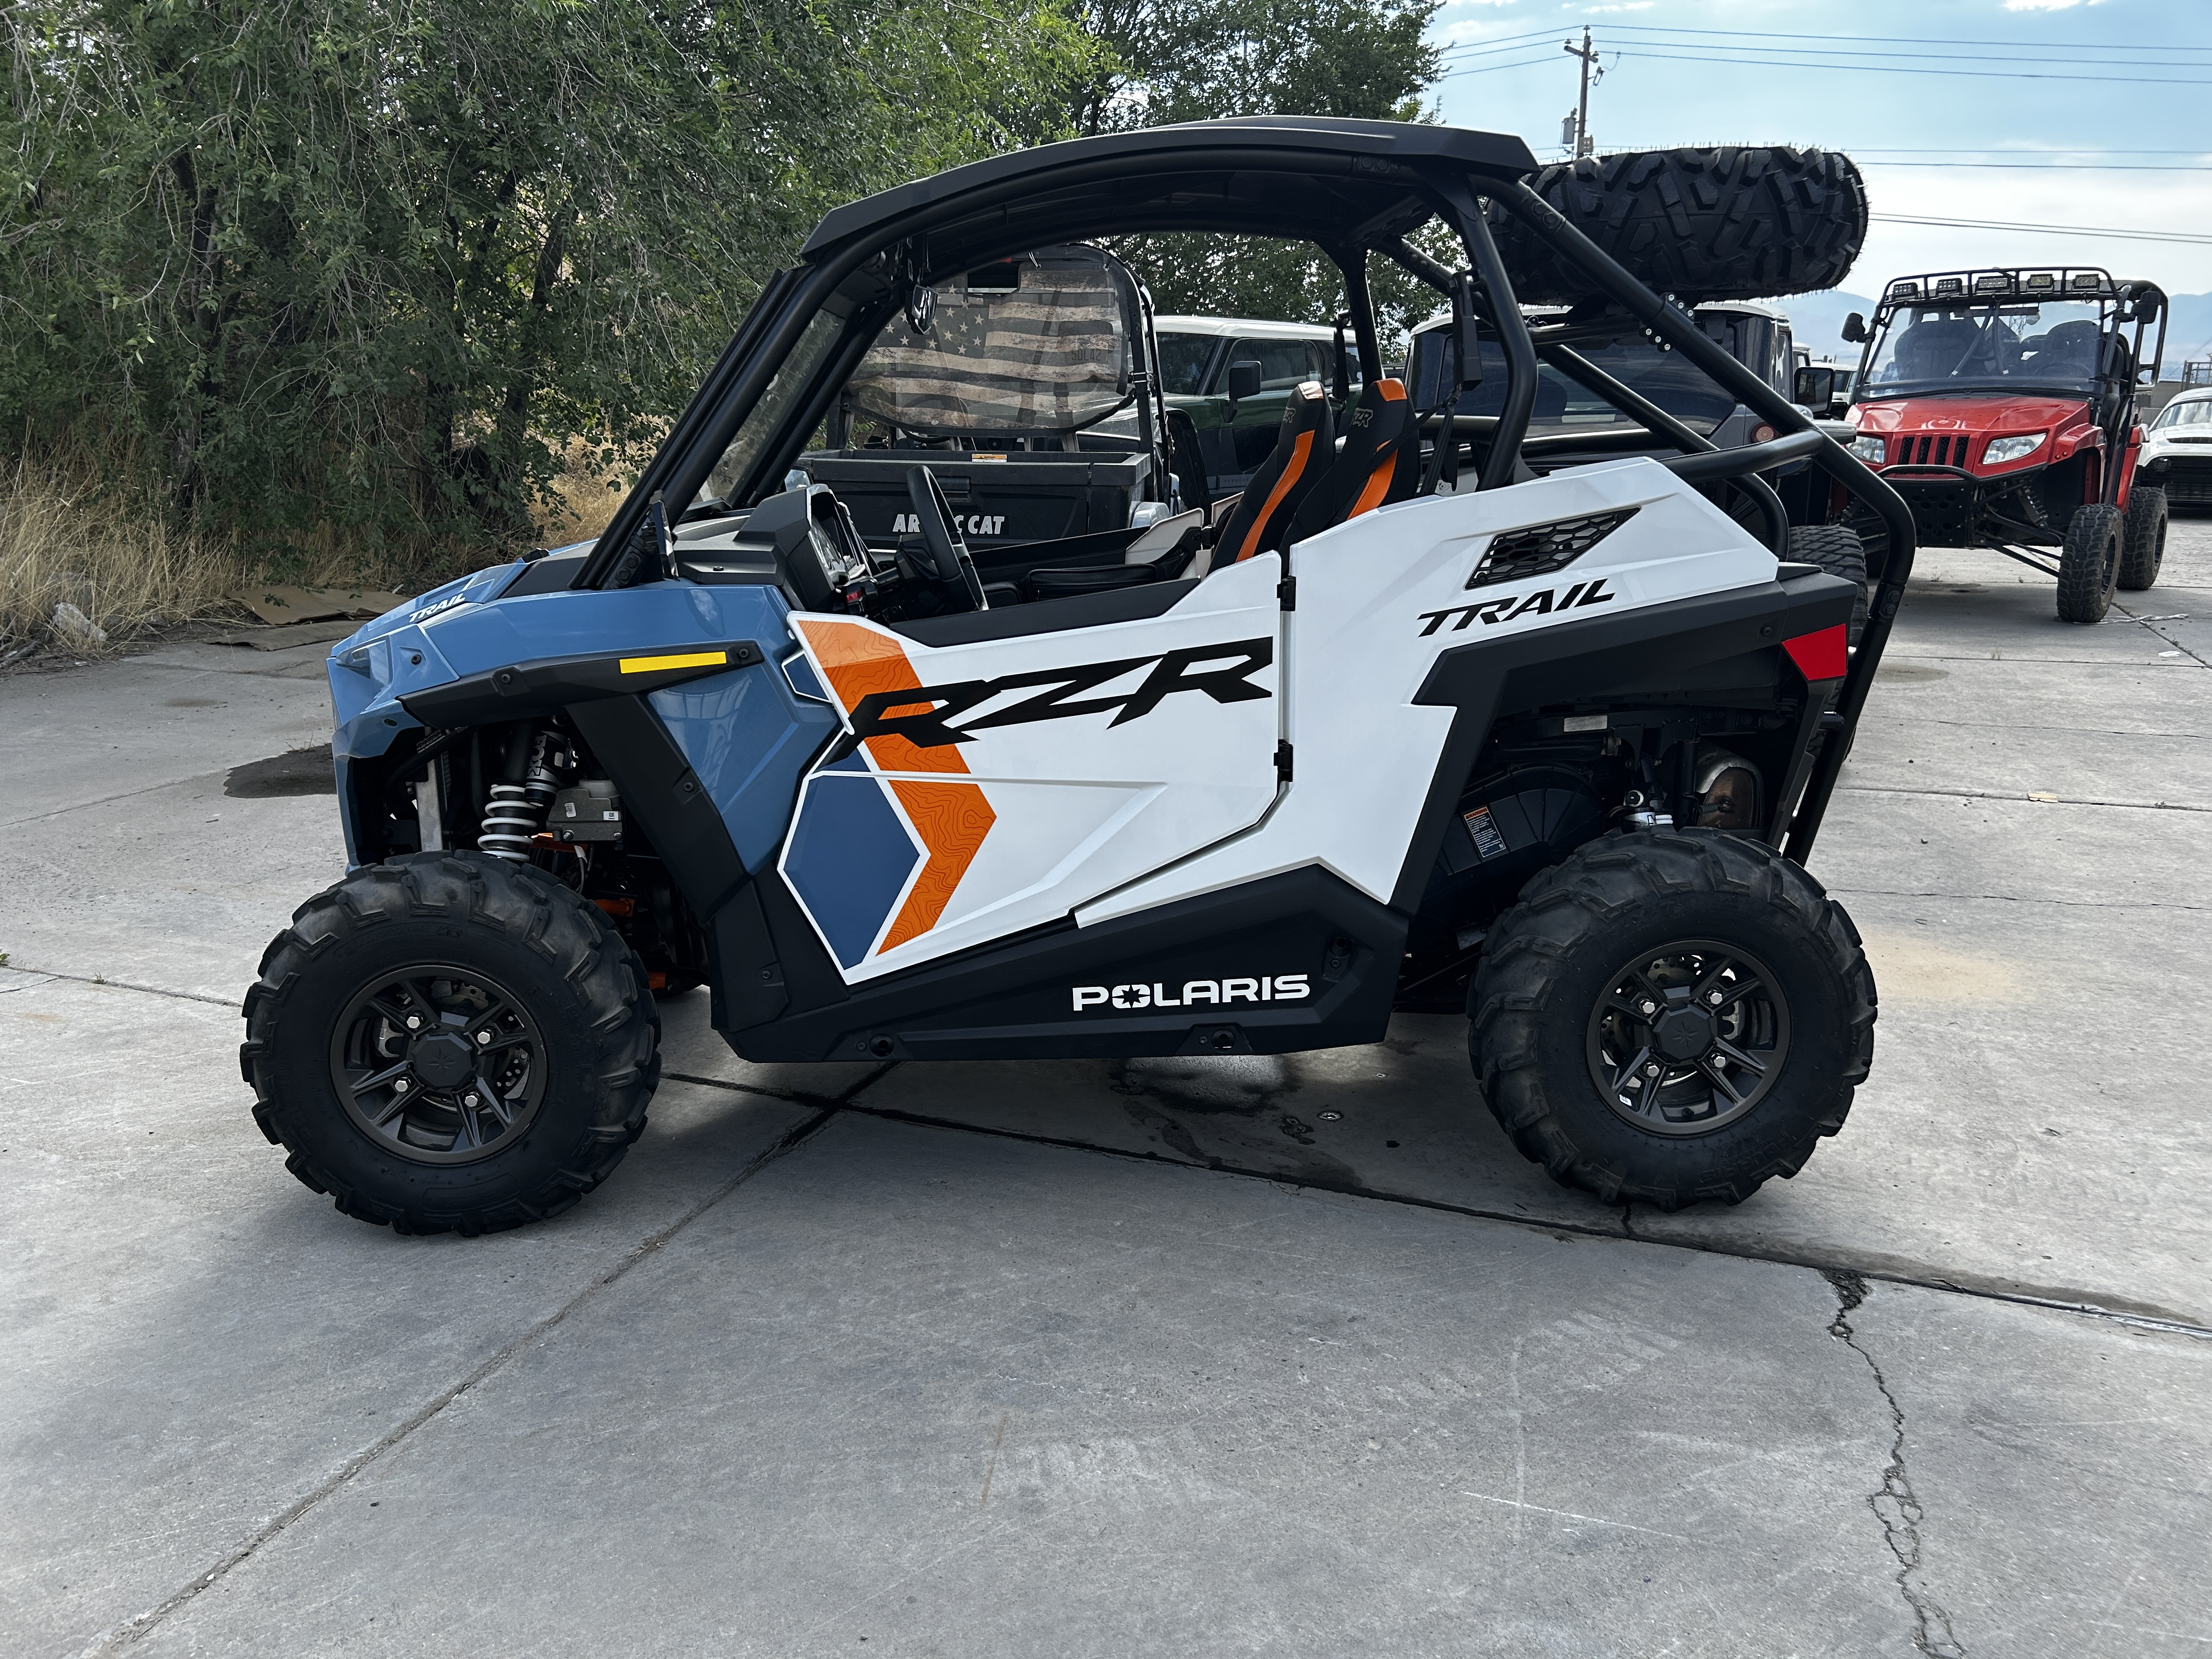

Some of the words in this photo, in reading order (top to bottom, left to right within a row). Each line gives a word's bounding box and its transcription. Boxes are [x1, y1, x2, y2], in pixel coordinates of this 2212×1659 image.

[892, 514, 964, 534] ARC
[968, 516, 1005, 534] CAT
[409, 592, 466, 623] TRAIL
[1417, 578, 1616, 638] TRAIL
[814, 636, 1273, 773] RZR
[527, 735, 548, 777] FOX
[1071, 974, 1310, 1012] POLARIS
